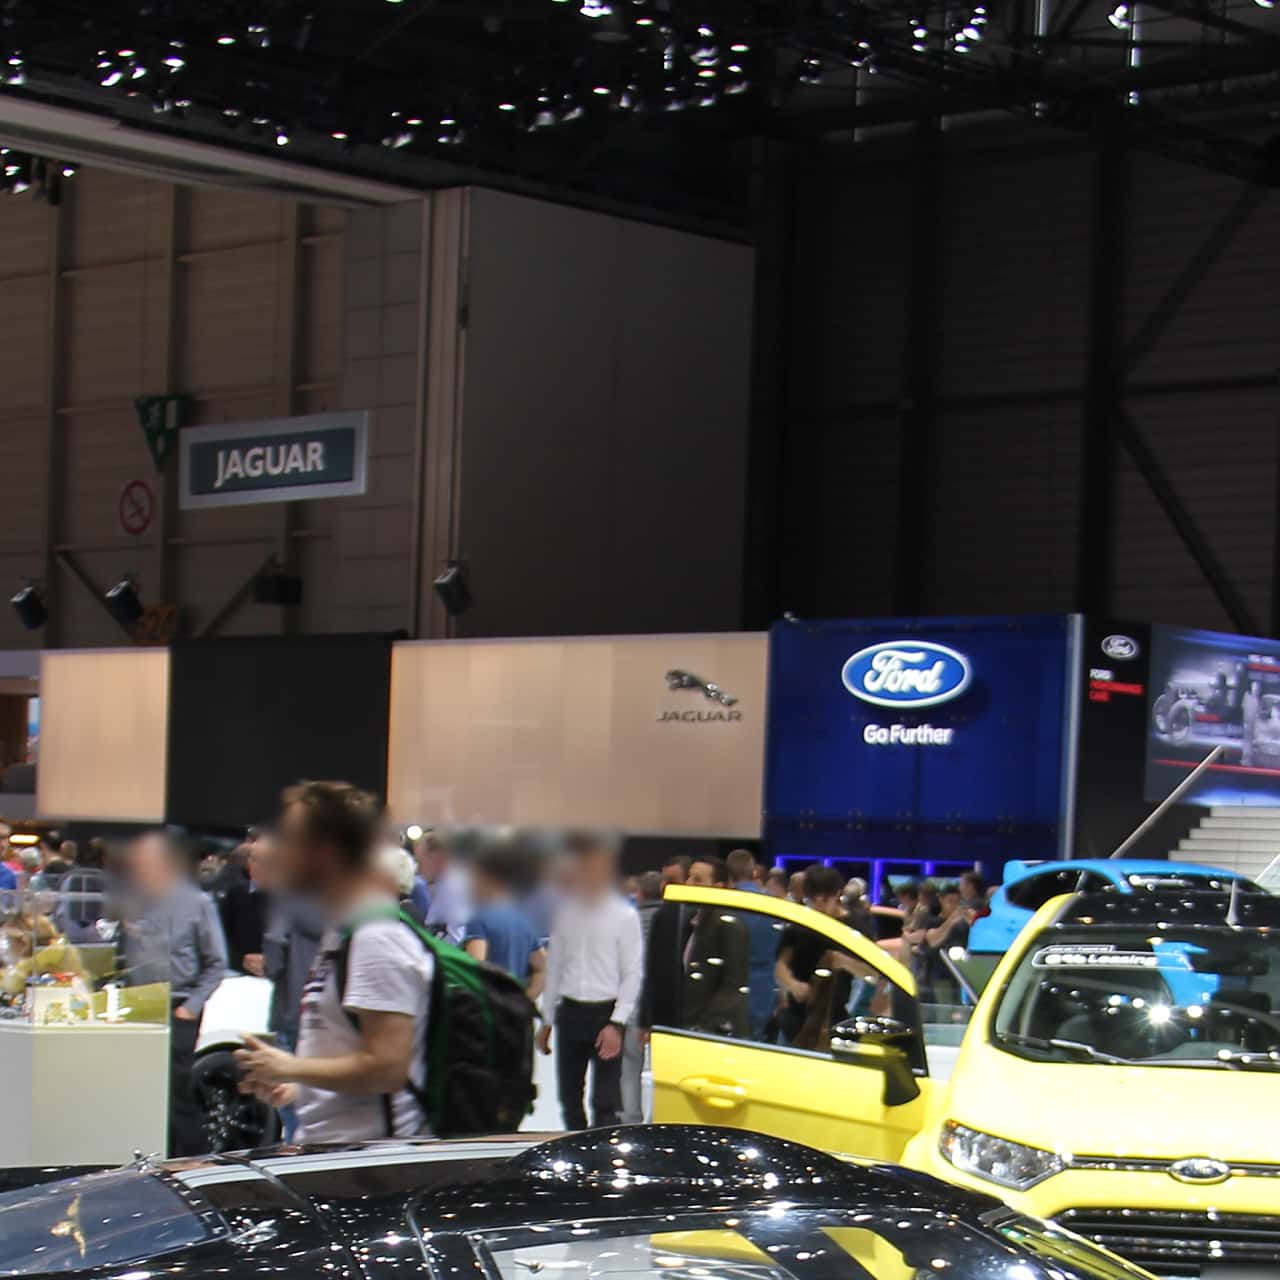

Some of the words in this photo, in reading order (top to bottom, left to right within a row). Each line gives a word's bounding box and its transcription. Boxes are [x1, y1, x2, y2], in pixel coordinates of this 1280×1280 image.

[213, 441, 325, 488] JAGUAR
[863, 650, 945, 693] Ford
[656, 710, 744, 722] JAGUAR
[864, 724, 888, 744] Go
[889, 724, 953, 744] Further
